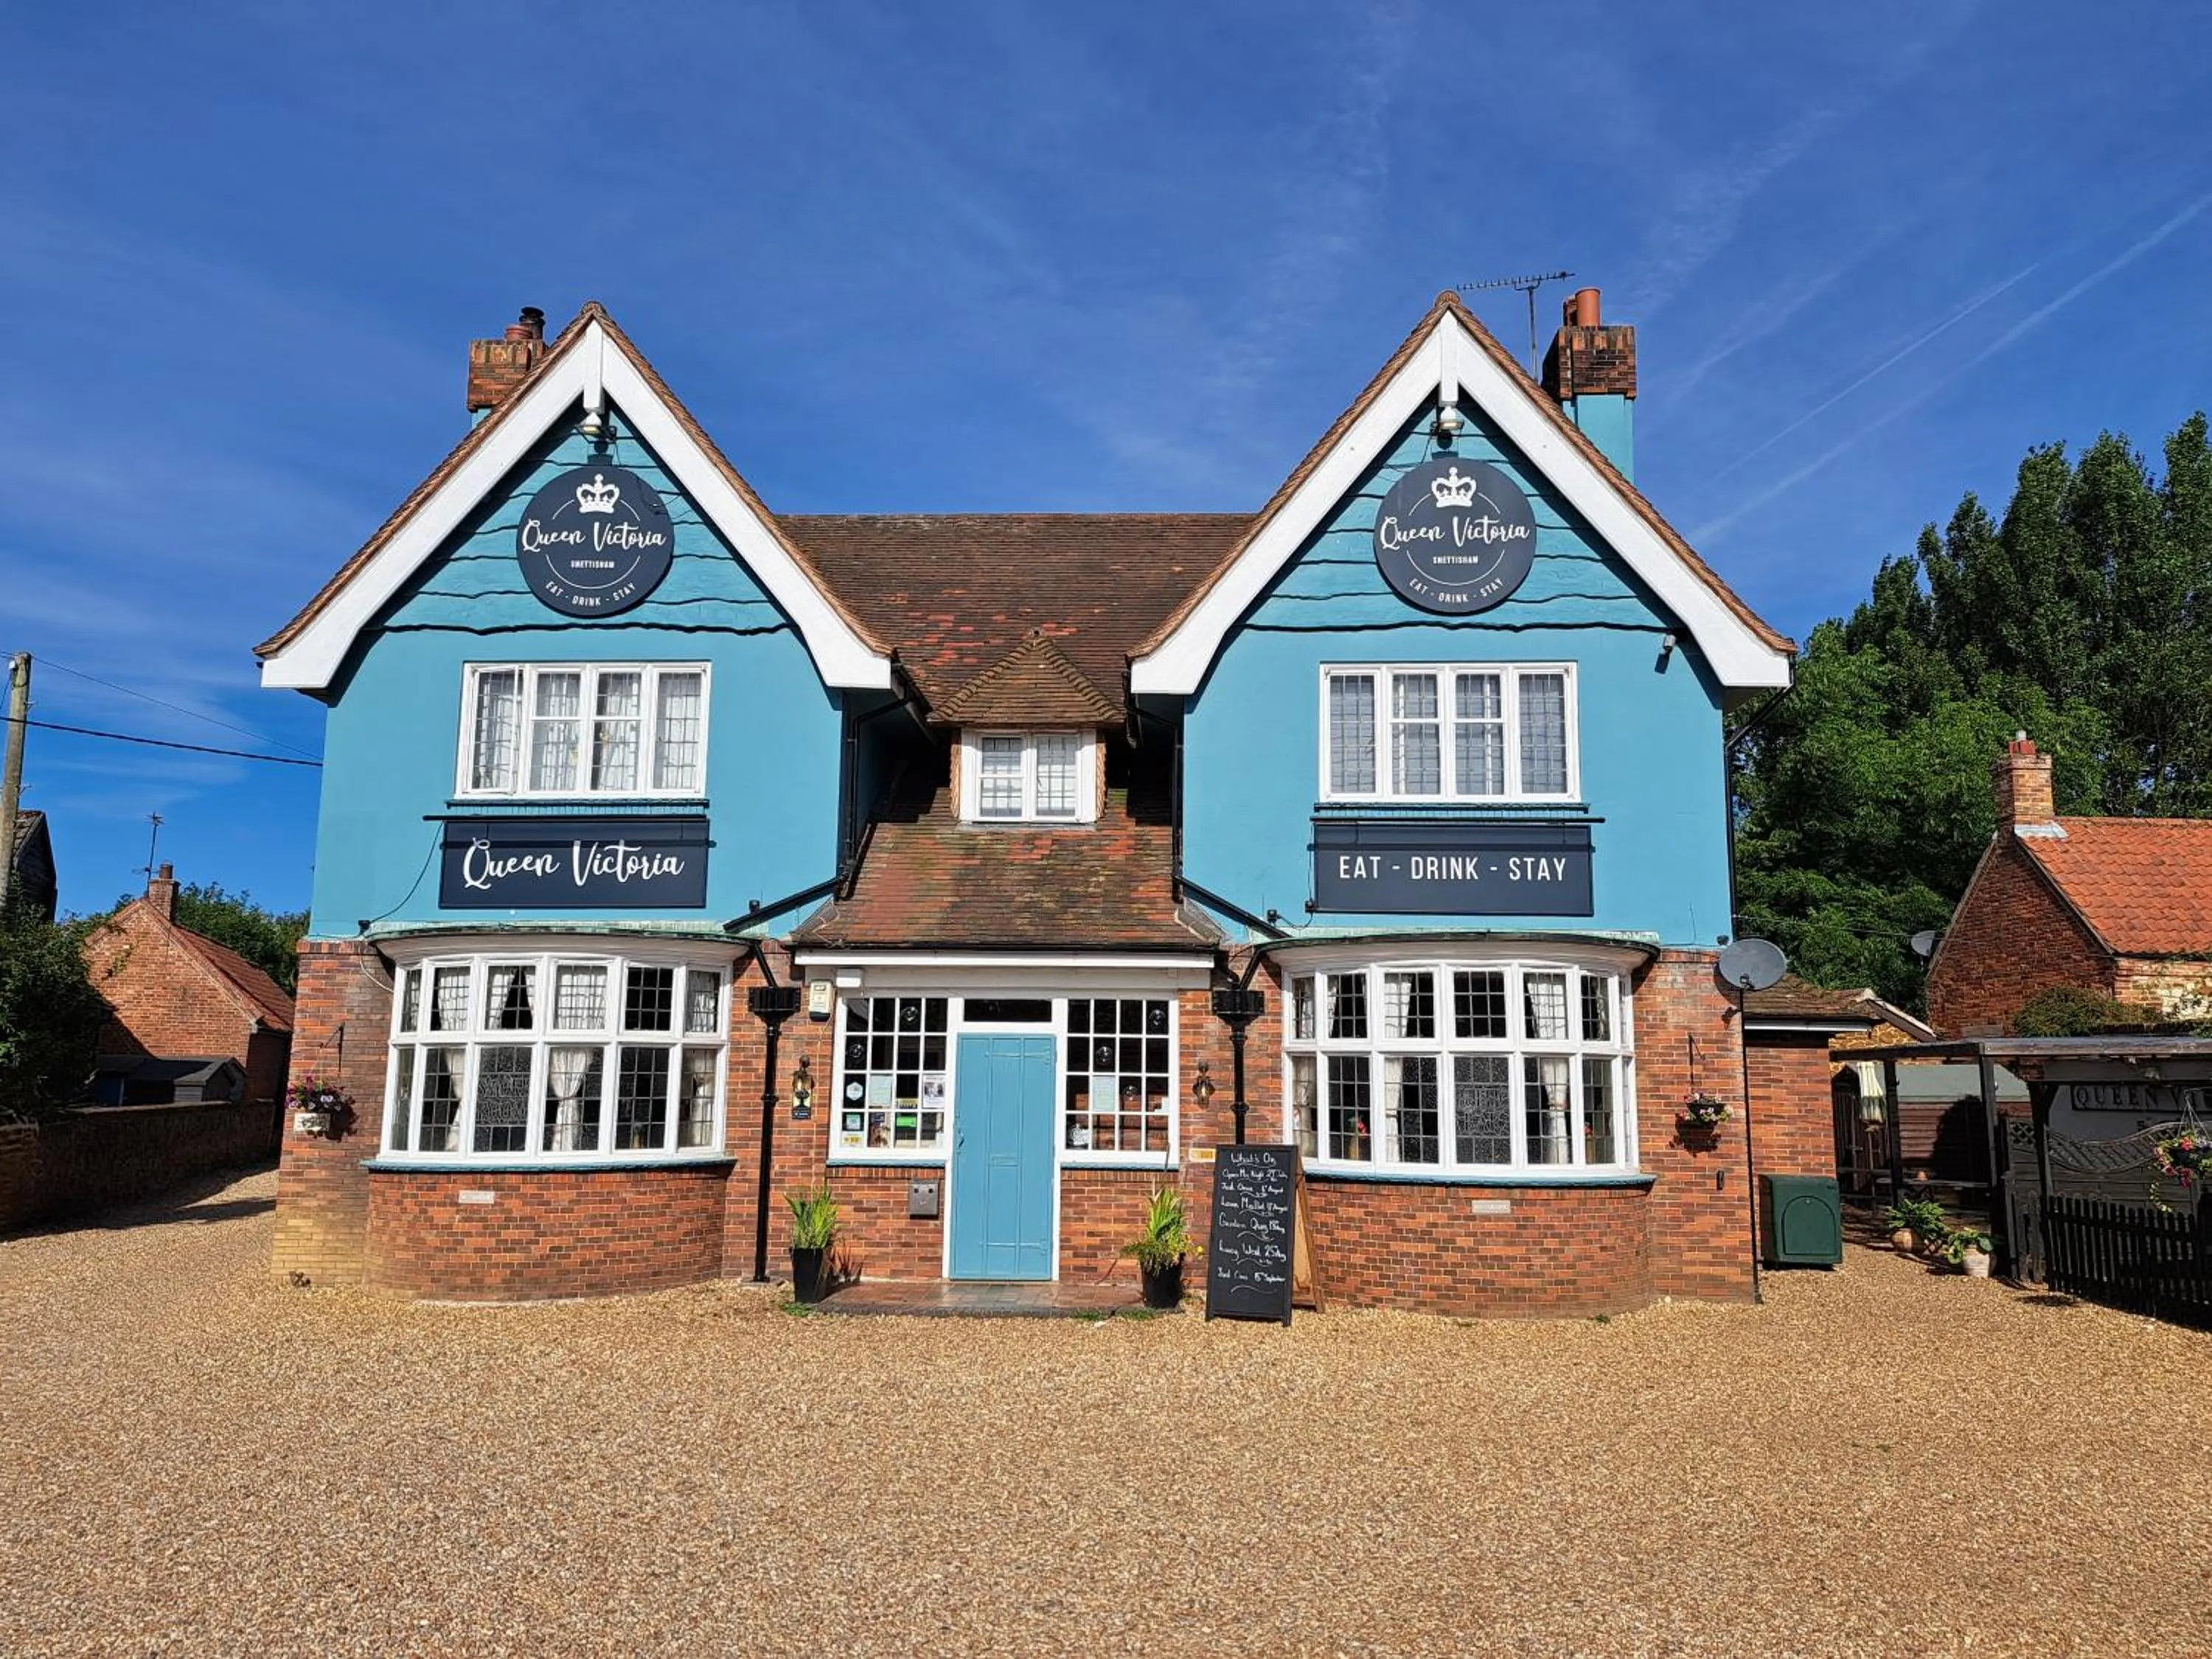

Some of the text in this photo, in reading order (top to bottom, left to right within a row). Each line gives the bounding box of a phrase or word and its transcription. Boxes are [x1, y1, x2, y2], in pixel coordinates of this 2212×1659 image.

[522, 518, 667, 552] Queen Victoria
[1380, 515, 1530, 550] Queen Victoria
[545, 581, 563, 597] EAT
[571, 596, 601, 607] DRINK
[613, 582, 636, 601] STAY
[1409, 578, 1428, 594] EAT
[1439, 592, 1469, 603] DRINK
[1480, 577, 1503, 597] STAY
[463, 837, 685, 890] Queen Victoria
[1339, 855, 1381, 880] EAT
[1411, 856, 1479, 880] DRINK
[1509, 857, 1567, 882] STAY
[2076, 1085, 2158, 1107] QUEEN
